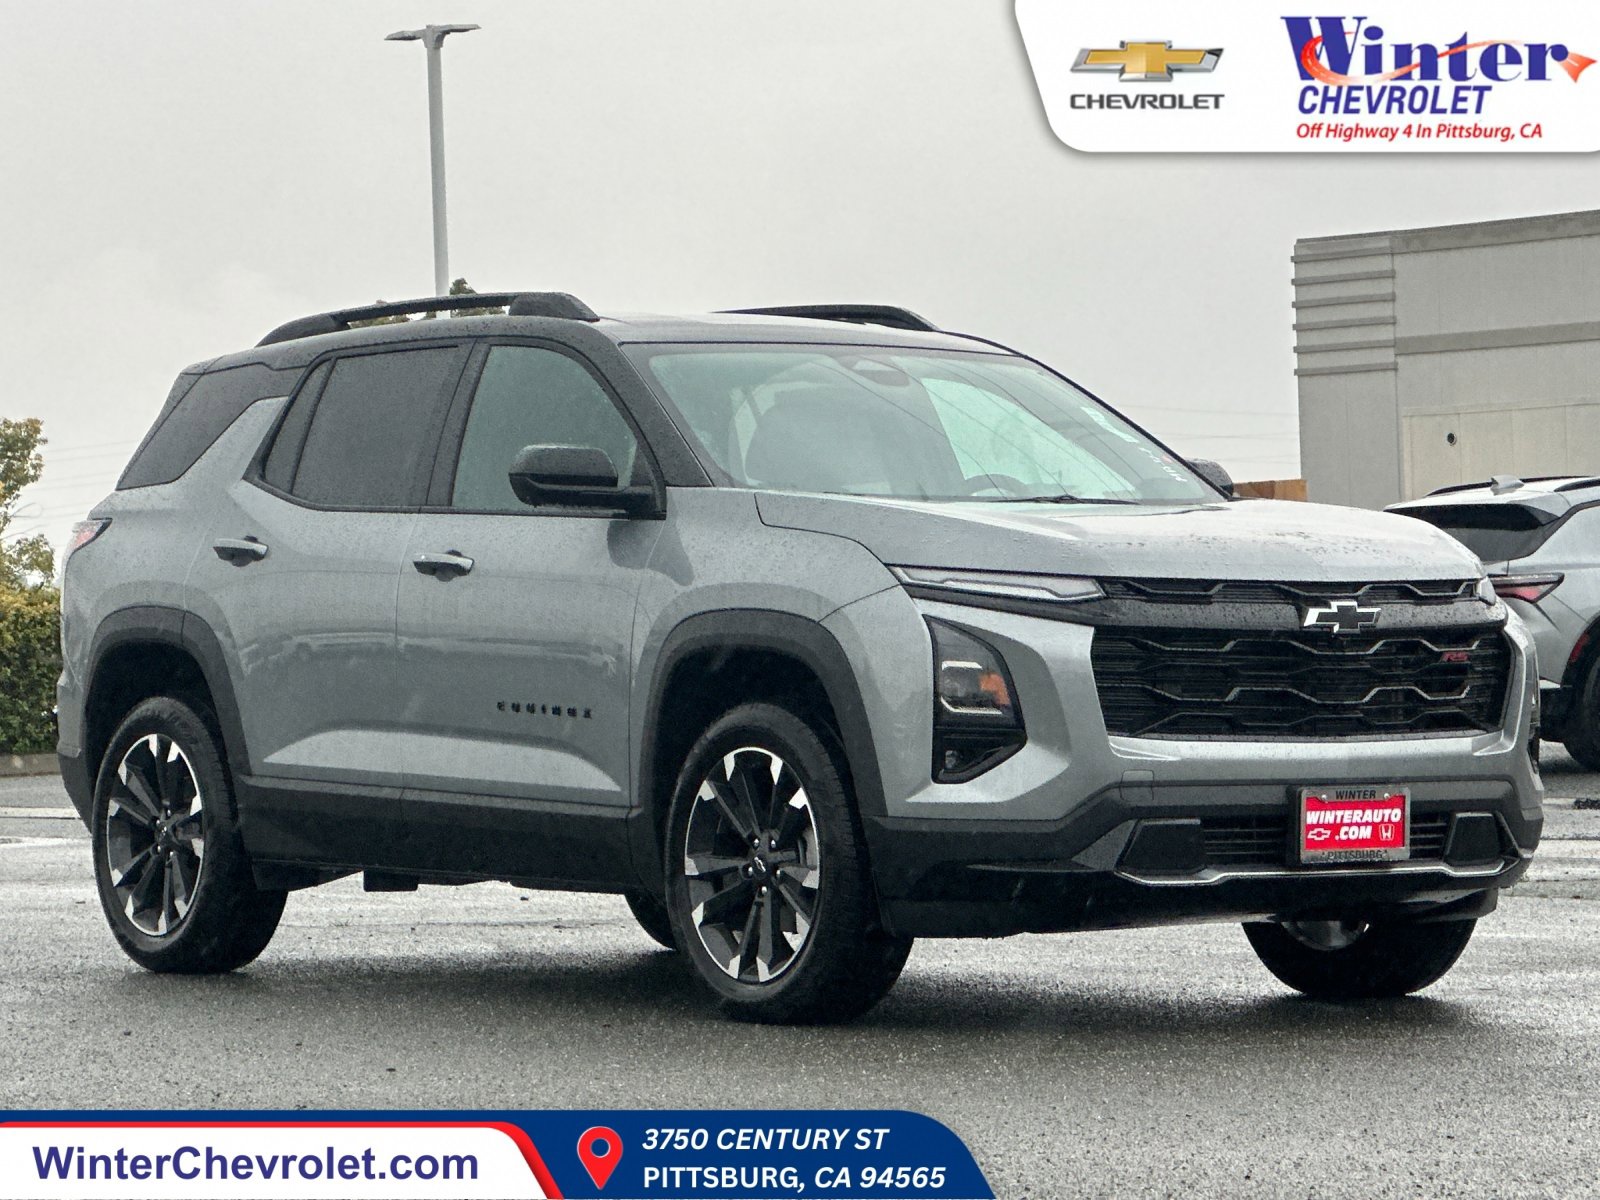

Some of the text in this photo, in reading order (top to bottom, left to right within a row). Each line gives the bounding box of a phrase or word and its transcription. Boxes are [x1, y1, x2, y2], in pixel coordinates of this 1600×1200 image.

[1335, 789, 1377, 800] WINTER
[1306, 808, 1402, 825] WINTERAUTO
[1334, 825, 1373, 840] .COM
[1327, 849, 1384, 860] PITTSBURG
